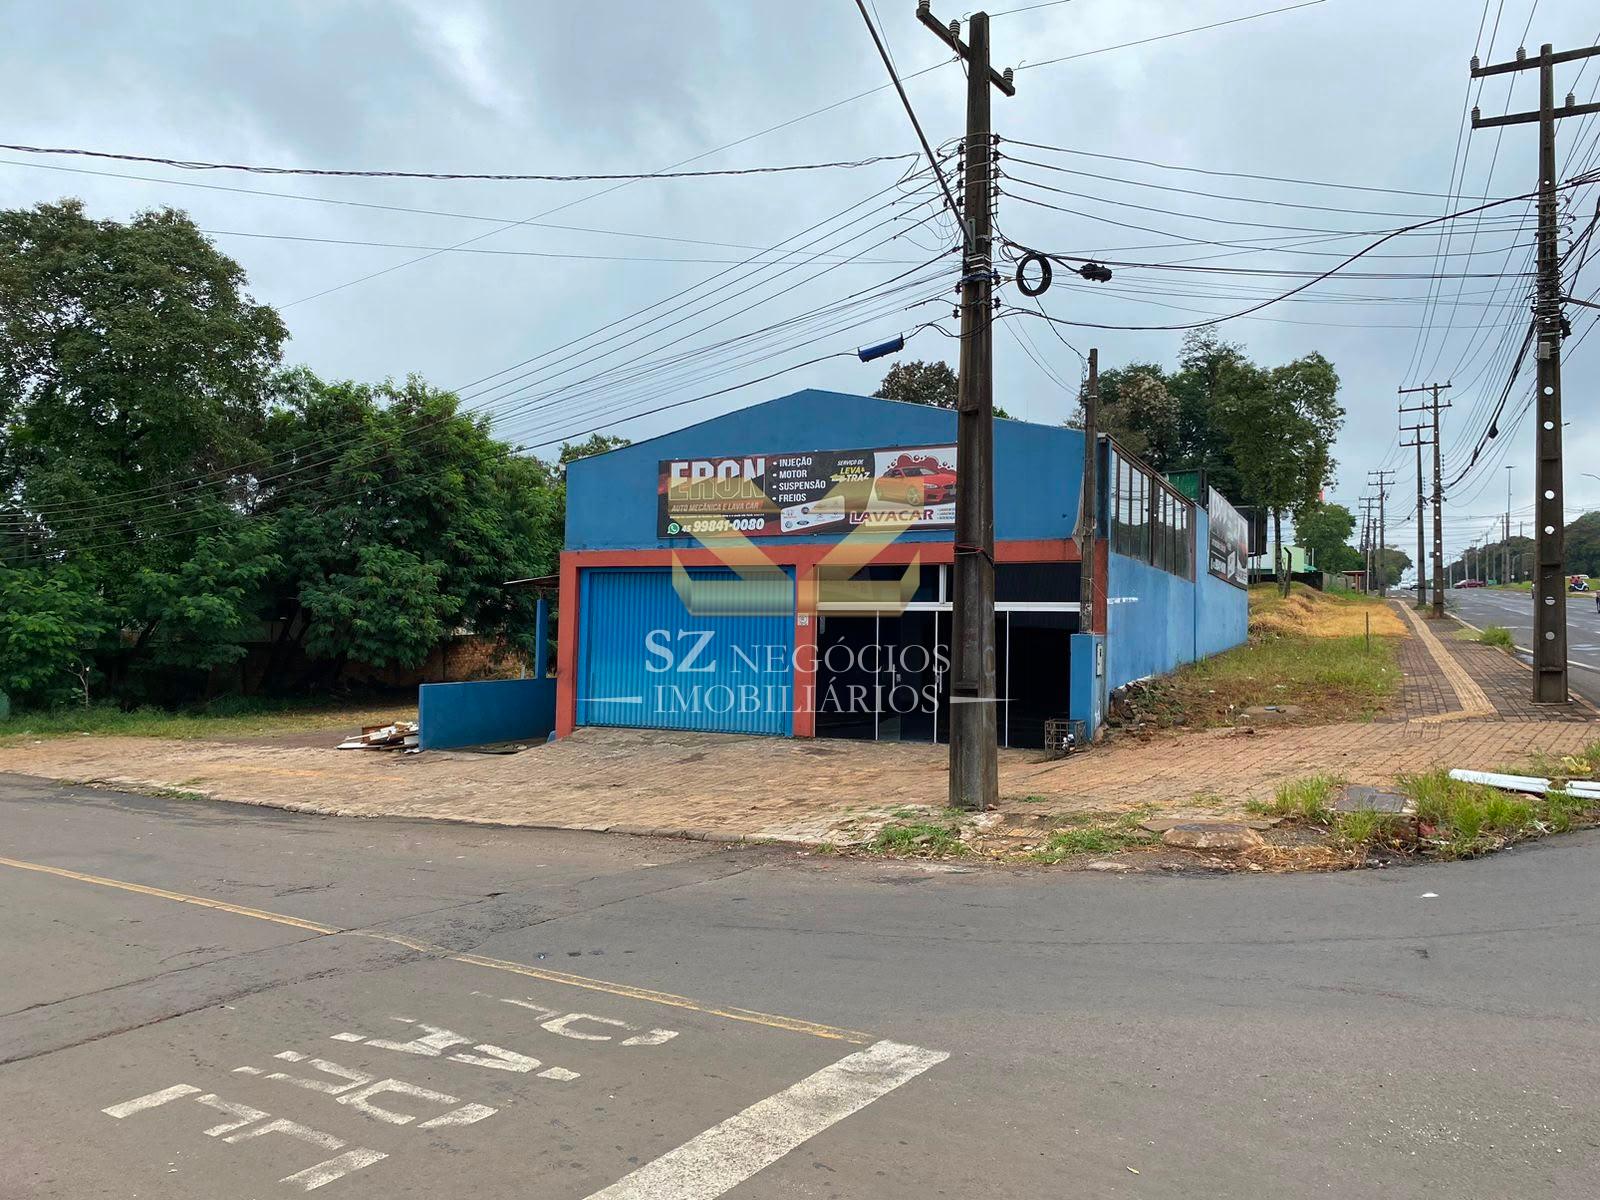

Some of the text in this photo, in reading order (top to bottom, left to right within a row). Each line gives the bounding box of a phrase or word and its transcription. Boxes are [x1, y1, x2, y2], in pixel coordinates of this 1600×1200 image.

[779, 456, 812, 468] INJEÇÃO
[779, 470, 807, 479] MOTOR
[840, 467, 861, 475] LEVA
[846, 471, 870, 482] TRAZ
[669, 458, 765, 501] ERON
[778, 480, 826, 491] SUSPENSÃO
[778, 493, 807, 503] FREIOS
[671, 504, 688, 512] AUTO
[688, 502, 722, 512] MECÂNICA
[849, 509, 935, 524] LAVACAR
[682, 518, 765, 533] 45 99841-0080
